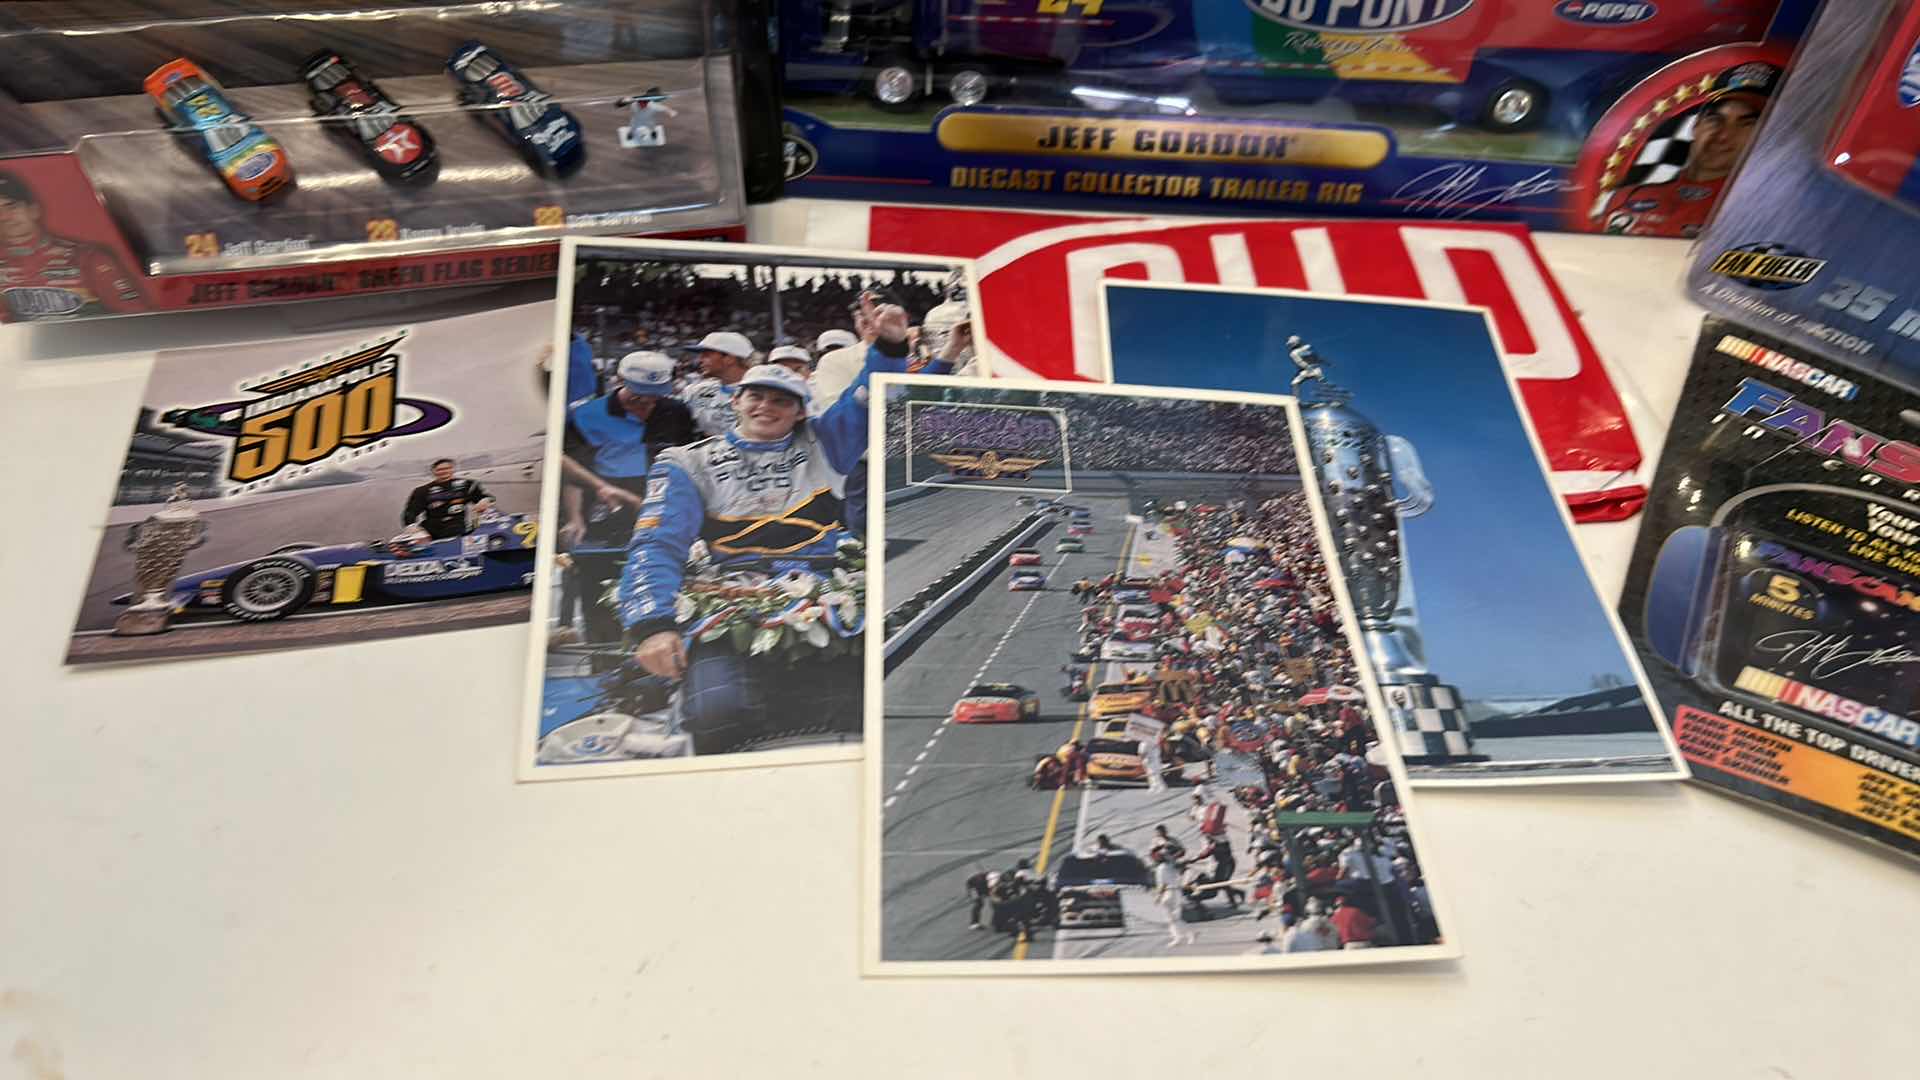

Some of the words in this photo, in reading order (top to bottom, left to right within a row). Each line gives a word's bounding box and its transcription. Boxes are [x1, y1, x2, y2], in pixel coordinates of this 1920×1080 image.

[1579, 3, 1650, 20] PEPSI
[1037, 125, 1117, 151] JEFF
[950, 166, 1056, 191] DIECAST
[1063, 171, 1203, 199] COLLECTOR
[1208, 177, 1315, 202] TRAILER
[1316, 182, 1366, 206] RIG
[185, 232, 219, 258] 24
[432, 256, 485, 283] FLAG
[1712, 251, 1755, 277] FAN
[1754, 256, 1820, 282] FUELER
[1699, 283, 1714, 295] A
[1717, 288, 1776, 318] Division
[1776, 309, 1799, 325] of
[1817, 276, 1898, 323] 35
[1757, 346, 1860, 400] NASCAR
[230, 374, 398, 483] 500
[1785, 508, 1845, 535] LISTEN
[1844, 528, 1868, 543] TO
[1847, 543, 1888, 563] LIVE
[1767, 574, 1801, 603] 5
[1748, 593, 1816, 620] MINUTES
[1718, 700, 1759, 724] ALL
[1760, 713, 1803, 738] THE
[1804, 727, 1848, 752] TOP
[1788, 680, 1920, 747] NASCAR
